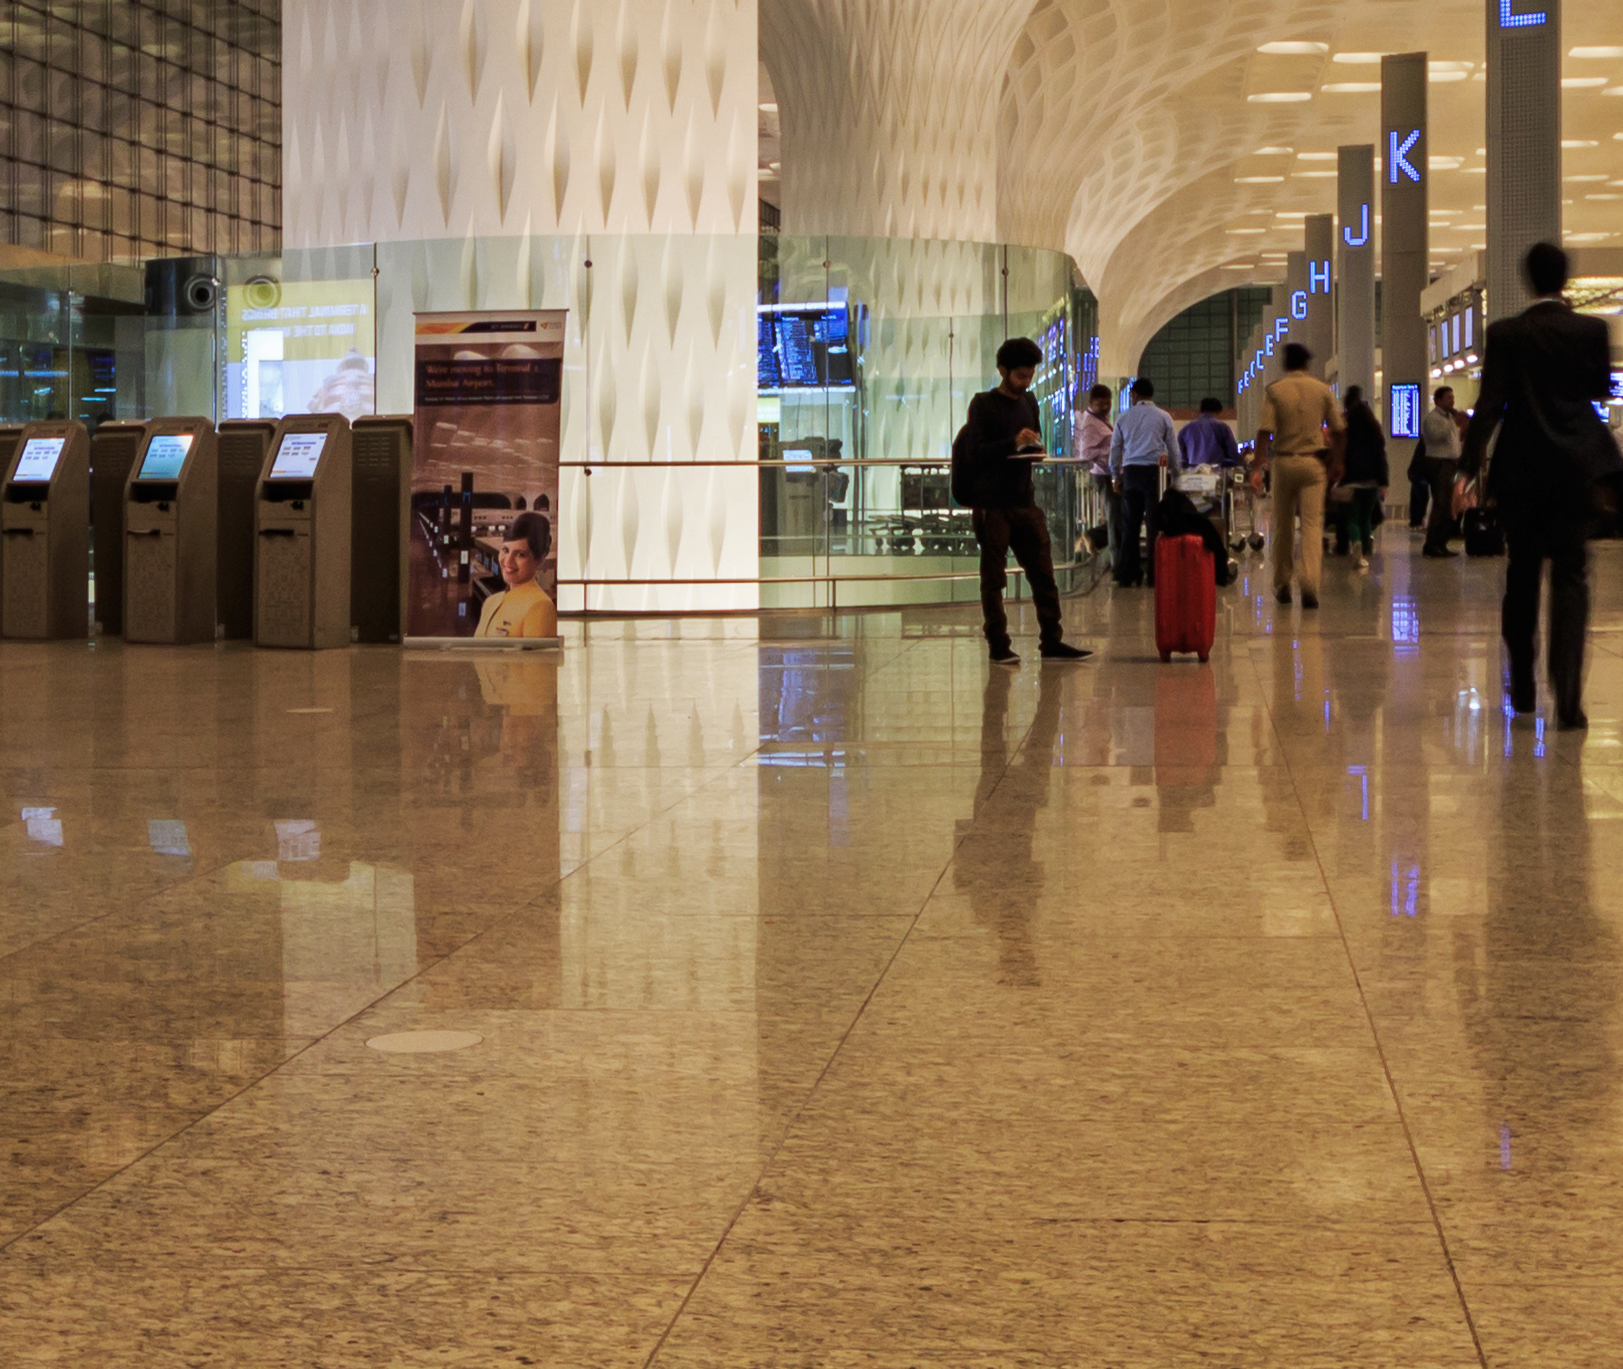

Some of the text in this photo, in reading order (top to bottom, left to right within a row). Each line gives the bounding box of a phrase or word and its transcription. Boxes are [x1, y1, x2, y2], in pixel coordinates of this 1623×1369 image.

[1390, 129, 1420, 183] K
[1344, 204, 1368, 246] J
[1309, 260, 1330, 294] H
[1291, 290, 1307, 320] G
[1275, 317, 1289, 342] F
[1264, 334, 1274, 357] E
[496, 362, 531, 373] Terminal
